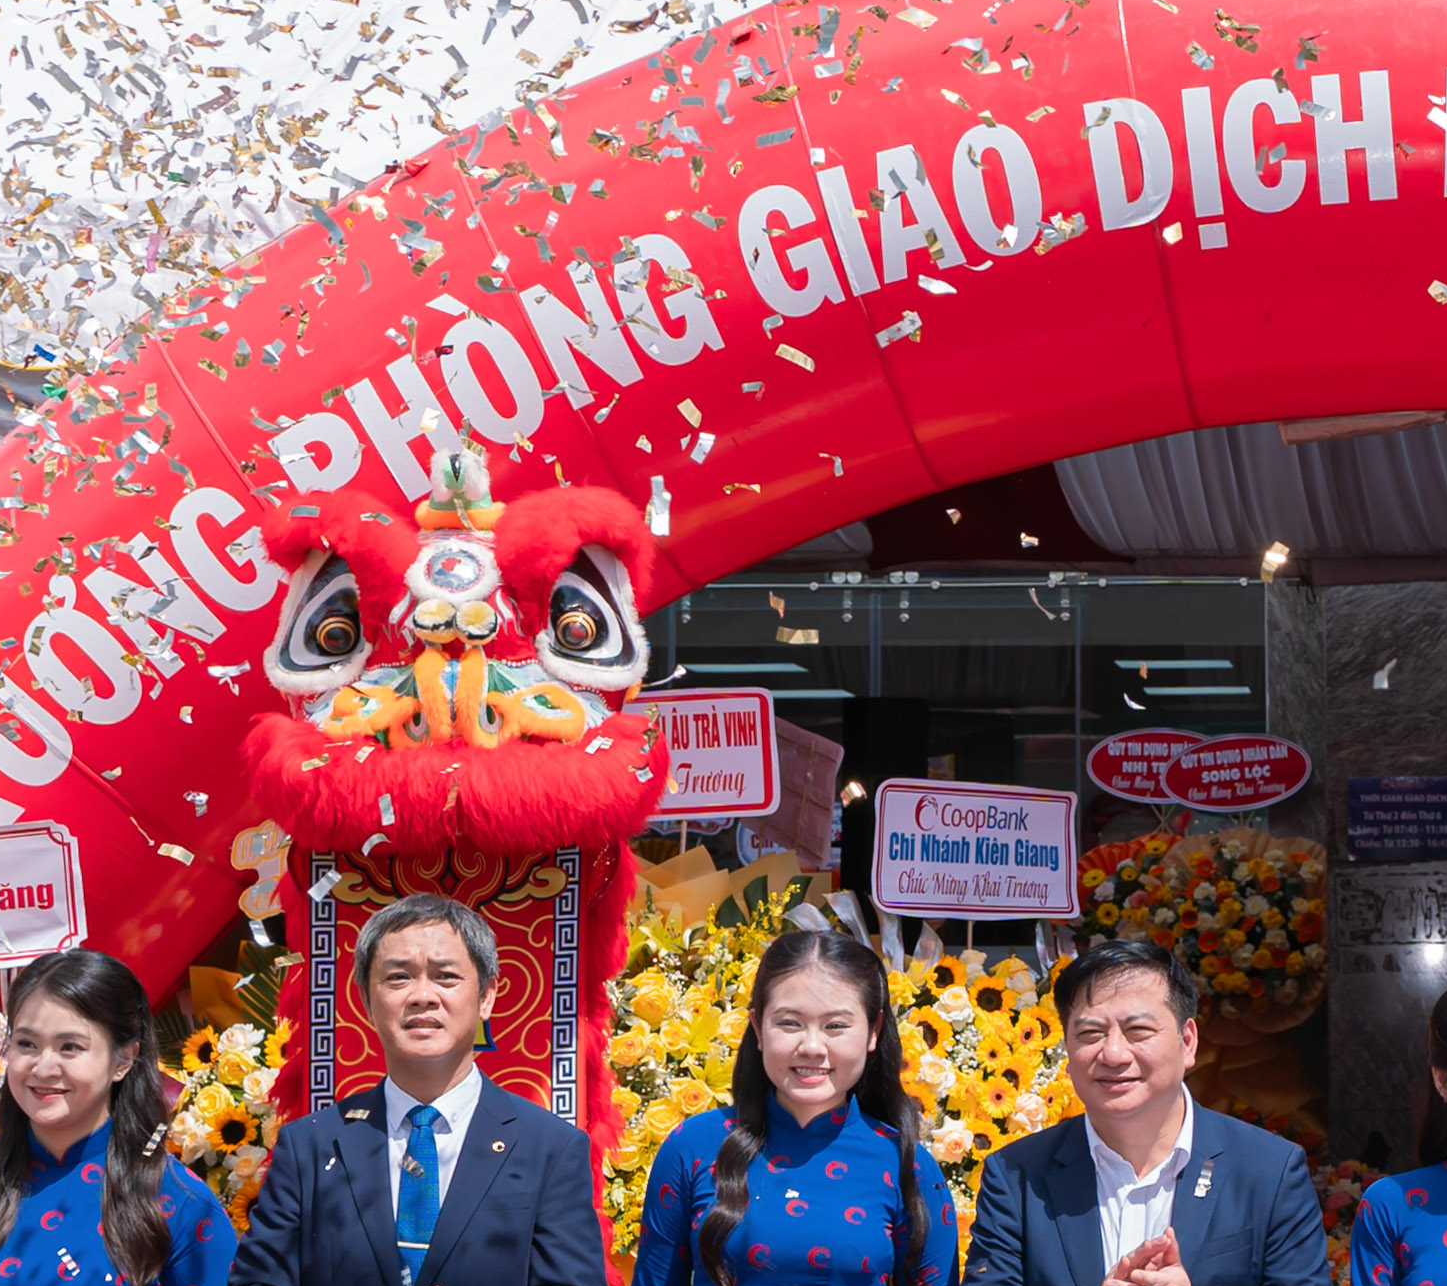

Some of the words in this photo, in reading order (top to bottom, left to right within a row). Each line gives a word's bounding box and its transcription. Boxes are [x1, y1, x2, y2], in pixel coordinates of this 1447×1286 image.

[275, 233, 726, 501] PHÒNG
[737, 122, 1043, 318] GIAO
[1083, 69, 1398, 250] DỊCH
[693, 705, 721, 749] TRÀ
[723, 711, 758, 748] VINH
[675, 763, 745, 799] Trương
[1201, 767, 1241, 785] SONG
[1244, 763, 1271, 782] LỘC
[889, 832, 916, 862] Chi
[920, 834, 970, 865] Nhánh
[975, 837, 1010, 866] Kiên
[1014, 839, 1059, 872] Giang
[898, 867, 929, 895] Chúc
[931, 871, 969, 903] Mừng
[972, 871, 1002, 903] Khai
[1006, 875, 1051, 907] Trương
